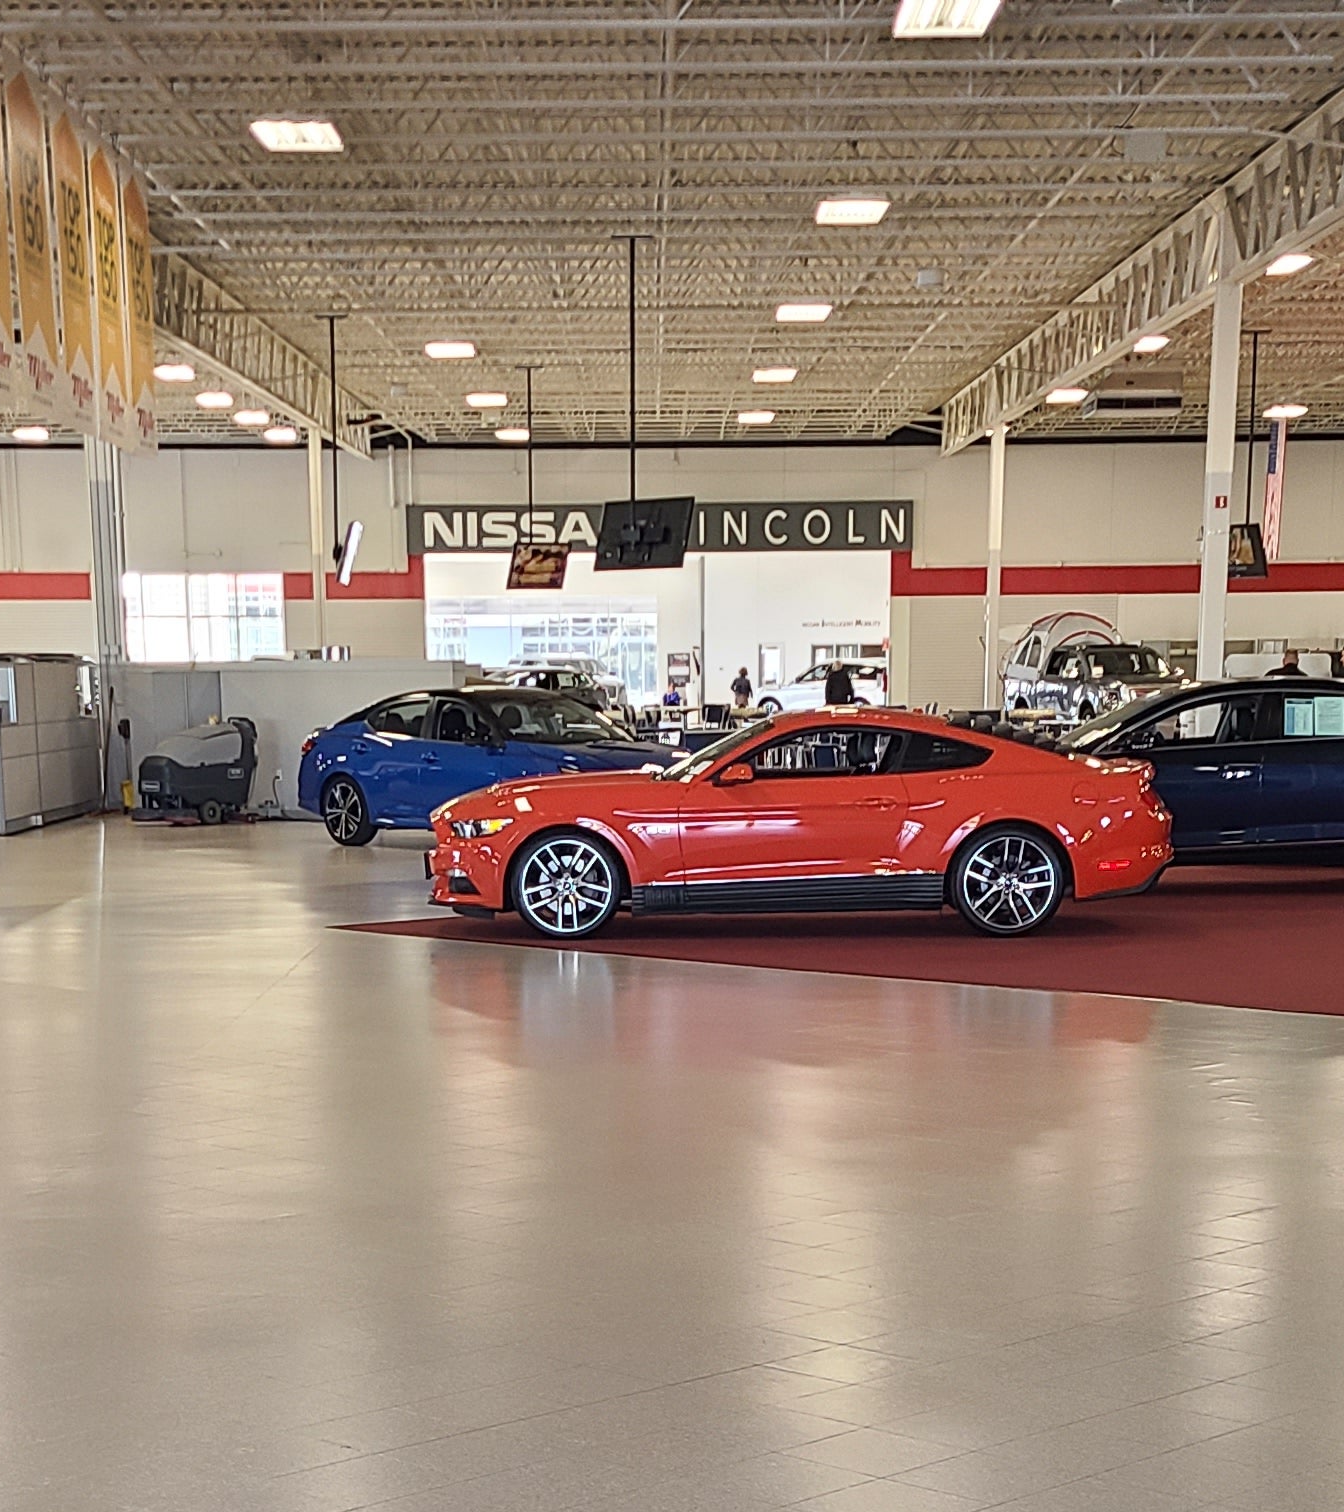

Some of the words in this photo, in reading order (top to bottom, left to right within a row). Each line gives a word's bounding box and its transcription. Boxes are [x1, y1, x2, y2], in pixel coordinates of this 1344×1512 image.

[20, 193, 45, 253] 150
[60, 180, 82, 225] TOP
[64, 226, 85, 279] 150
[96, 210, 116, 252] TOP
[99, 251, 117, 304] 150
[423, 511, 597, 548] NISSA
[699, 507, 906, 547] INCOLN
